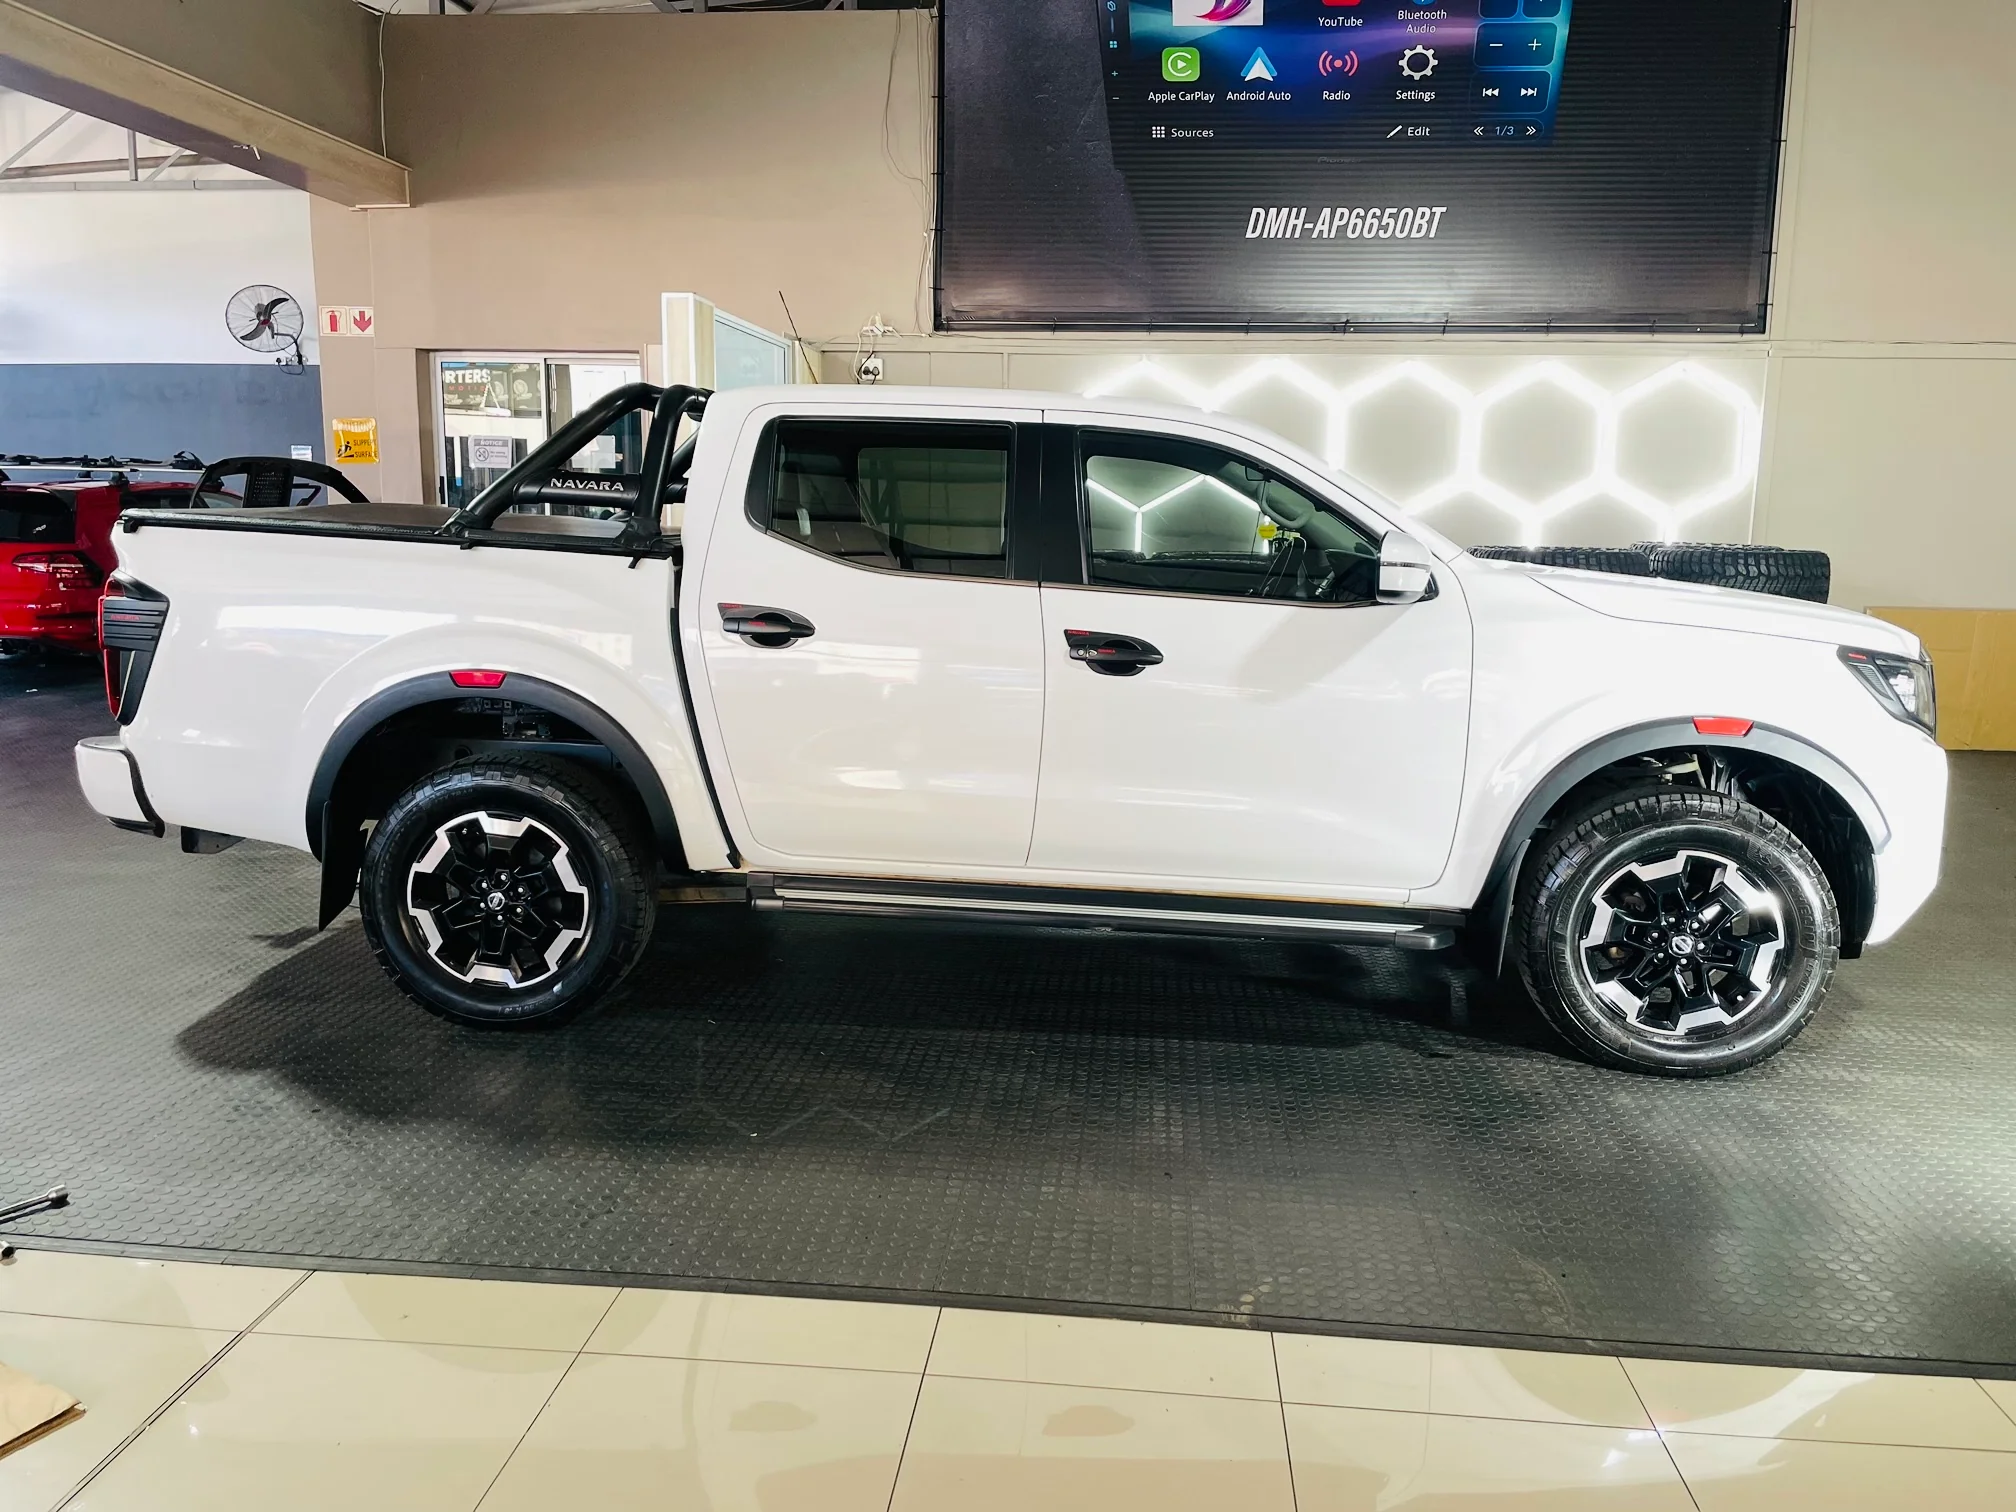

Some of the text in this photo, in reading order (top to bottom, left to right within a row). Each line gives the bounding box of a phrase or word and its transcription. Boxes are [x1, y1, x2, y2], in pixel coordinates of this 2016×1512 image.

[1397, 9, 1447, 20] Bluetooth
[1318, 16, 1363, 27] YouTube
[1406, 24, 1436, 34] Audio
[1148, 91, 1215, 103] Apple CarPlay
[1226, 91, 1292, 101] Android Auto
[1322, 90, 1351, 101] Radio
[1395, 90, 1436, 102] Settings
[1171, 128, 1214, 138] Sources
[1407, 127, 1431, 137] Edit
[1495, 125, 1514, 136] 1/3
[1245, 206, 1448, 240] DMH-AP6650BT
[443, 368, 491, 384] RTERS
[550, 478, 624, 491] NAVARA
